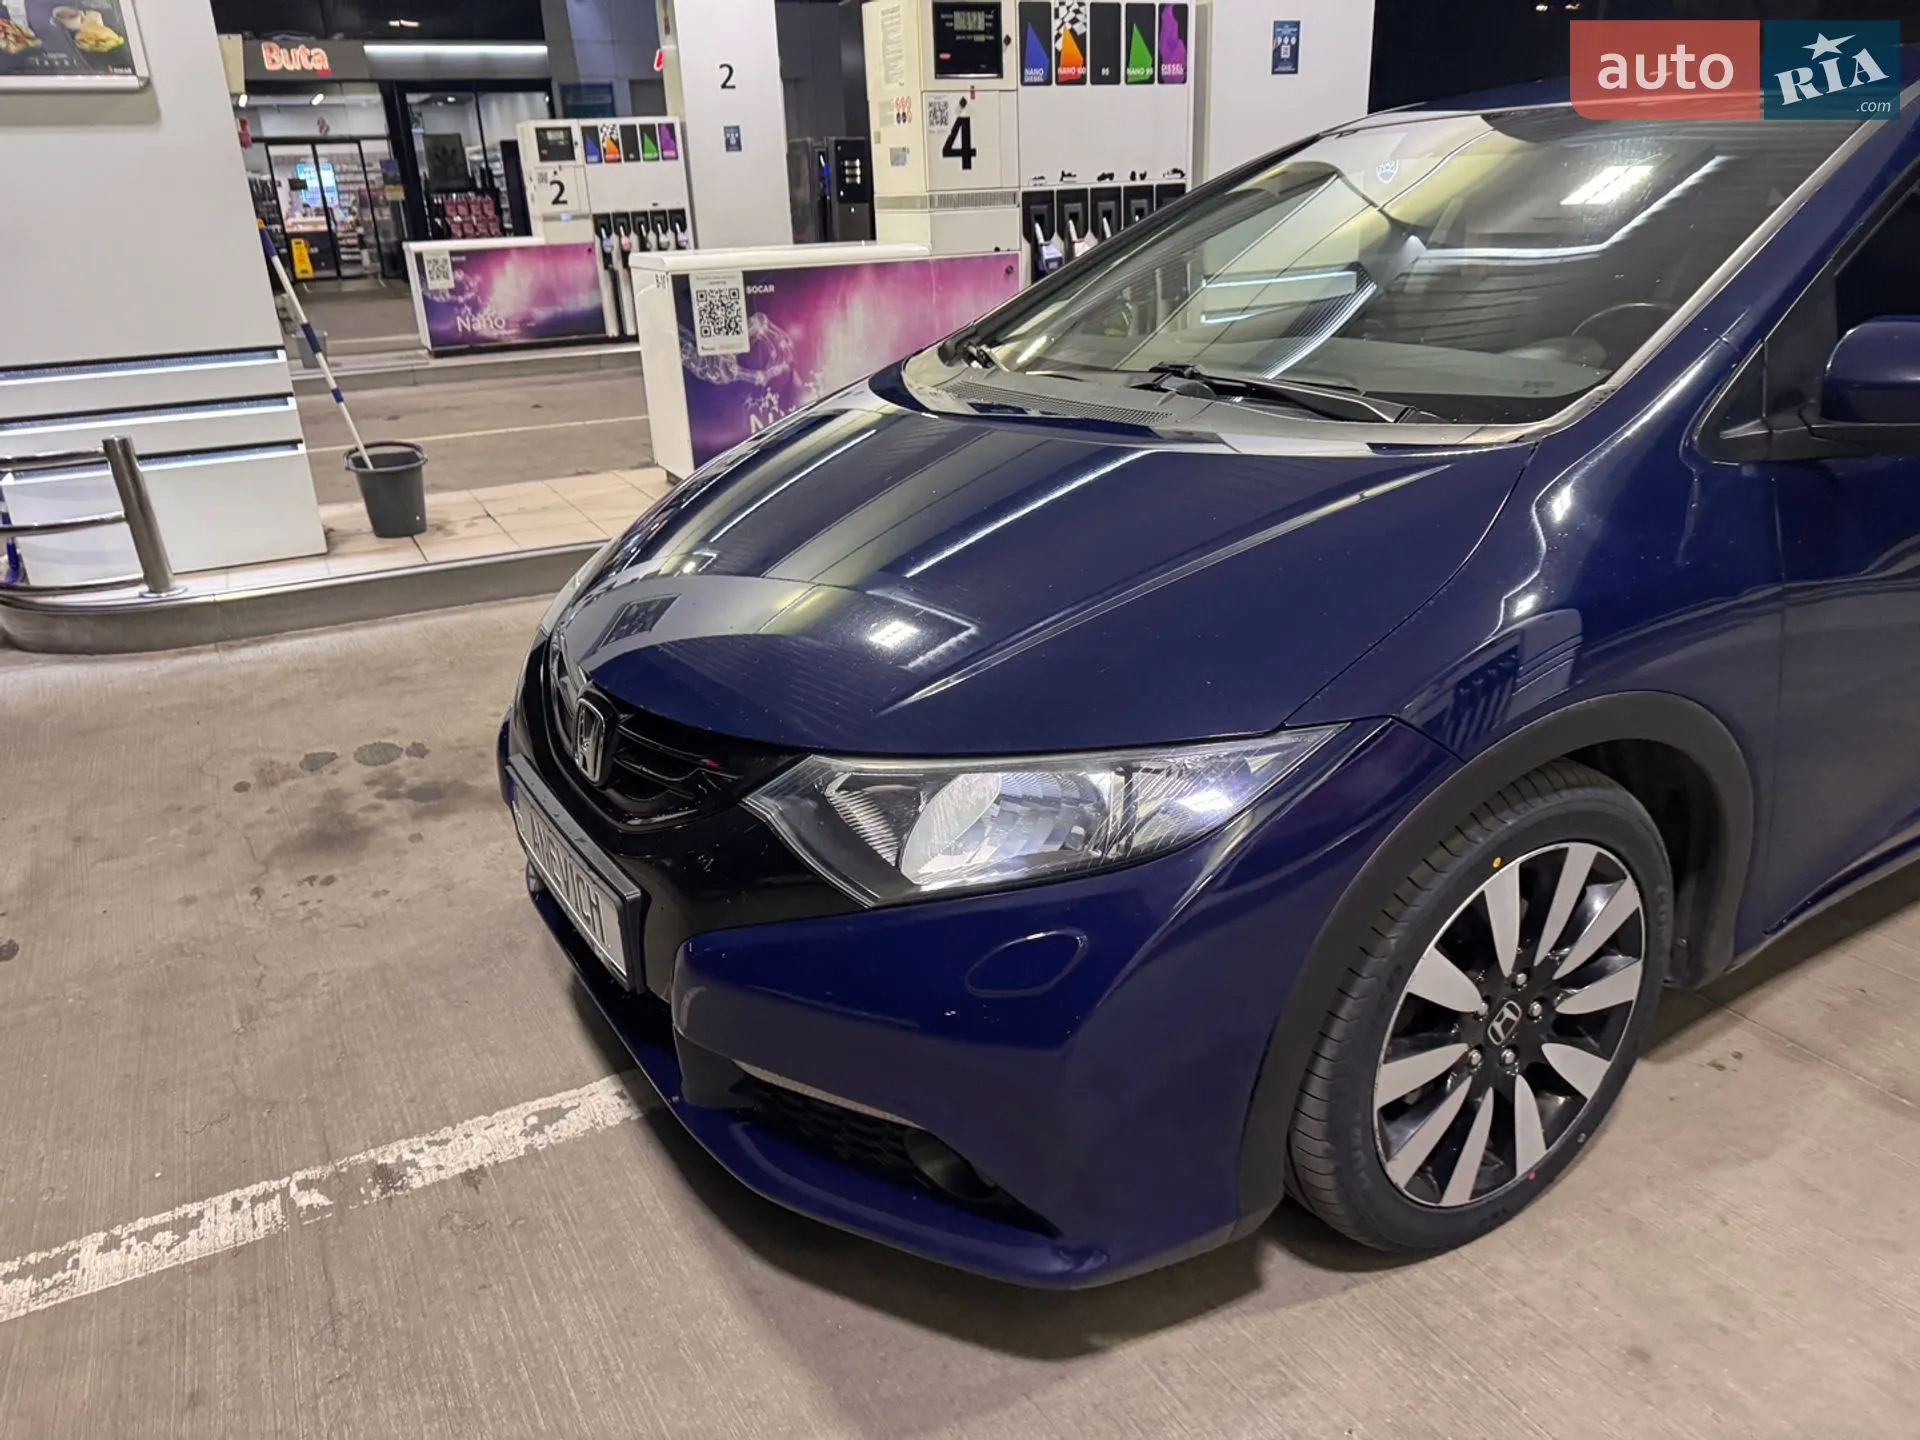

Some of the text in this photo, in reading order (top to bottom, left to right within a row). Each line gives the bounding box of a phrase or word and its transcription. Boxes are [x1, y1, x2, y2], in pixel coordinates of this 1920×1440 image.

[261, 41, 330, 72] Buta
[718, 63, 736, 89] 2
[1024, 66, 1045, 76] NANO
[1057, 66, 1076, 75] NANO
[1126, 67, 1145, 76] NANO
[942, 116, 977, 170] 4
[549, 179, 568, 205] 2
[746, 284, 775, 294] SOCAR
[456, 314, 506, 333] Nano
